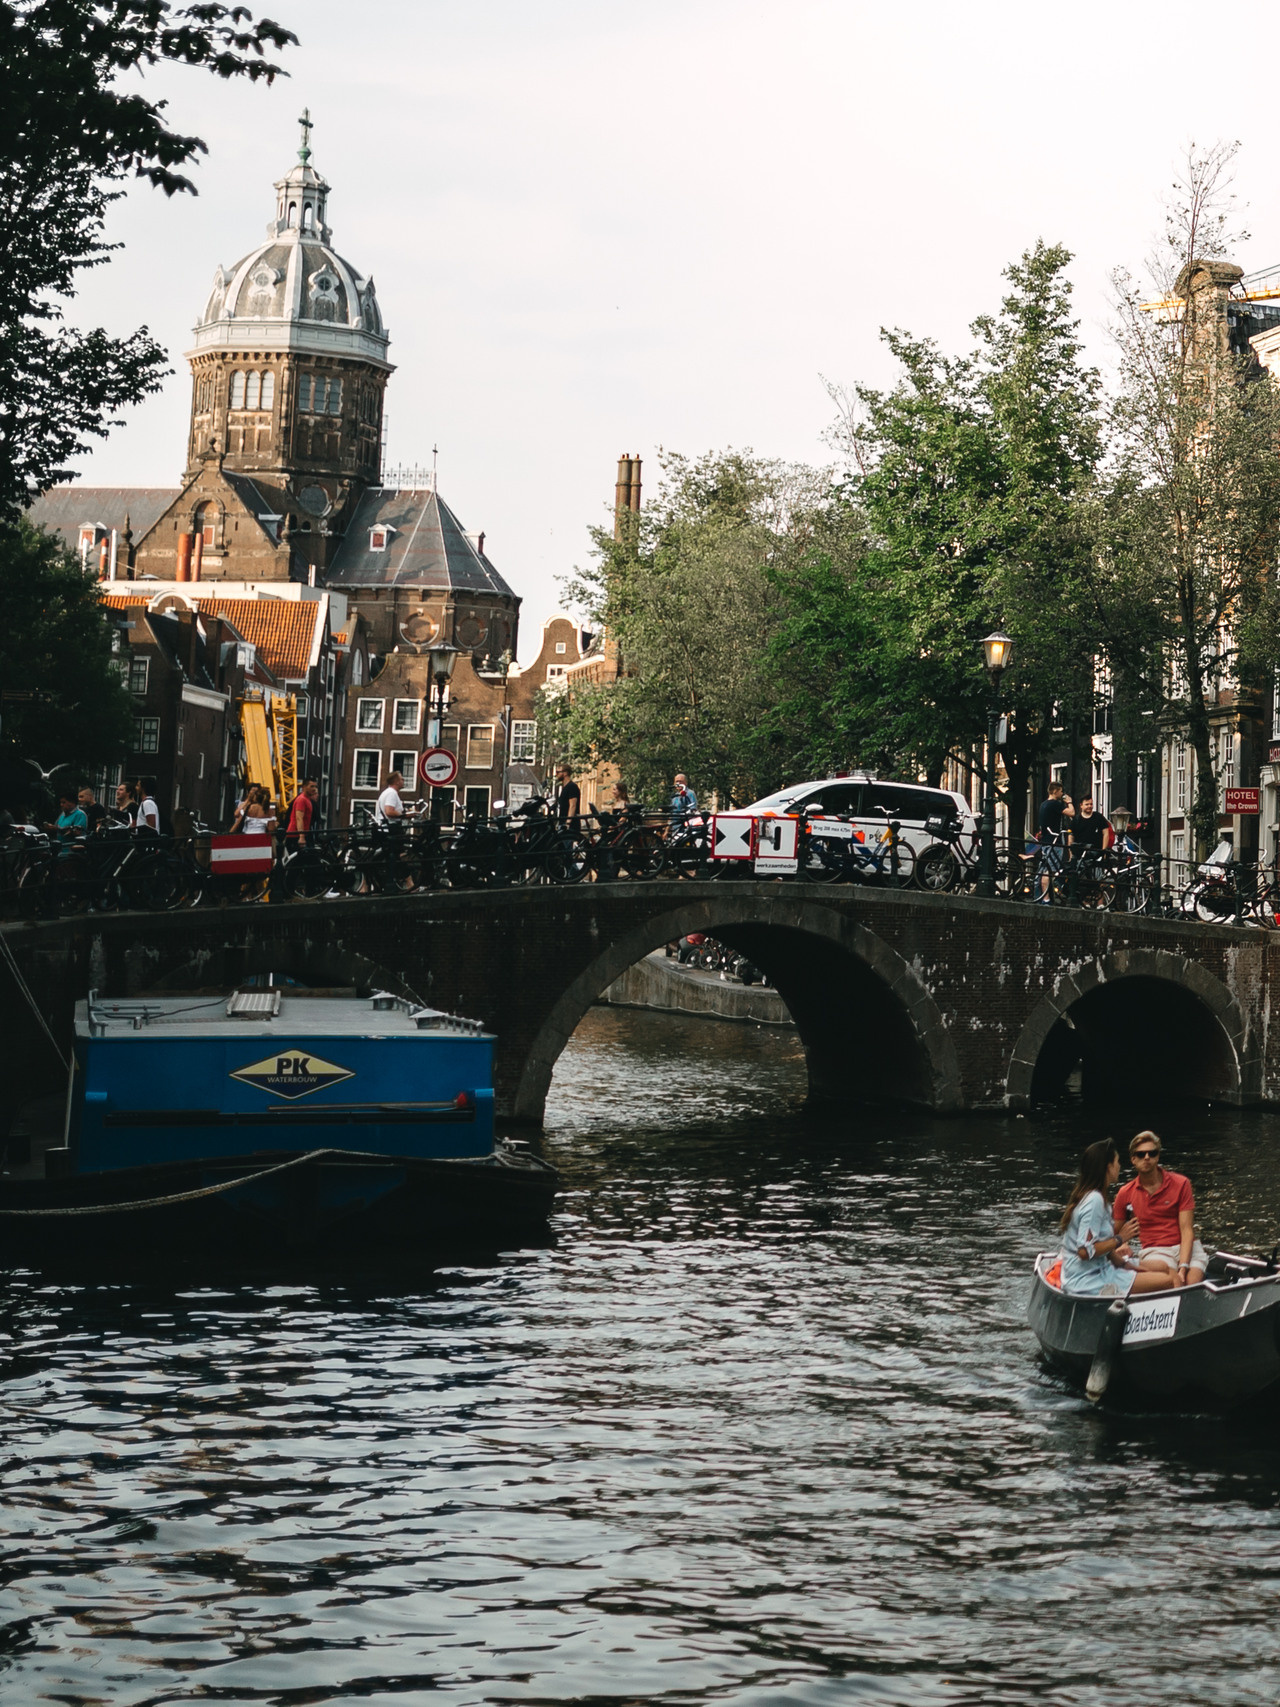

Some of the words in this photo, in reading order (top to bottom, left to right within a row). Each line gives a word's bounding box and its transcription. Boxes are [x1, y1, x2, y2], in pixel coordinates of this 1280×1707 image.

[1227, 791, 1257, 800] HOTEL
[1238, 802, 1257, 810] Crown
[276, 1058, 310, 1075] PK
[1124, 1307, 1175, 1335] Boats4rent
